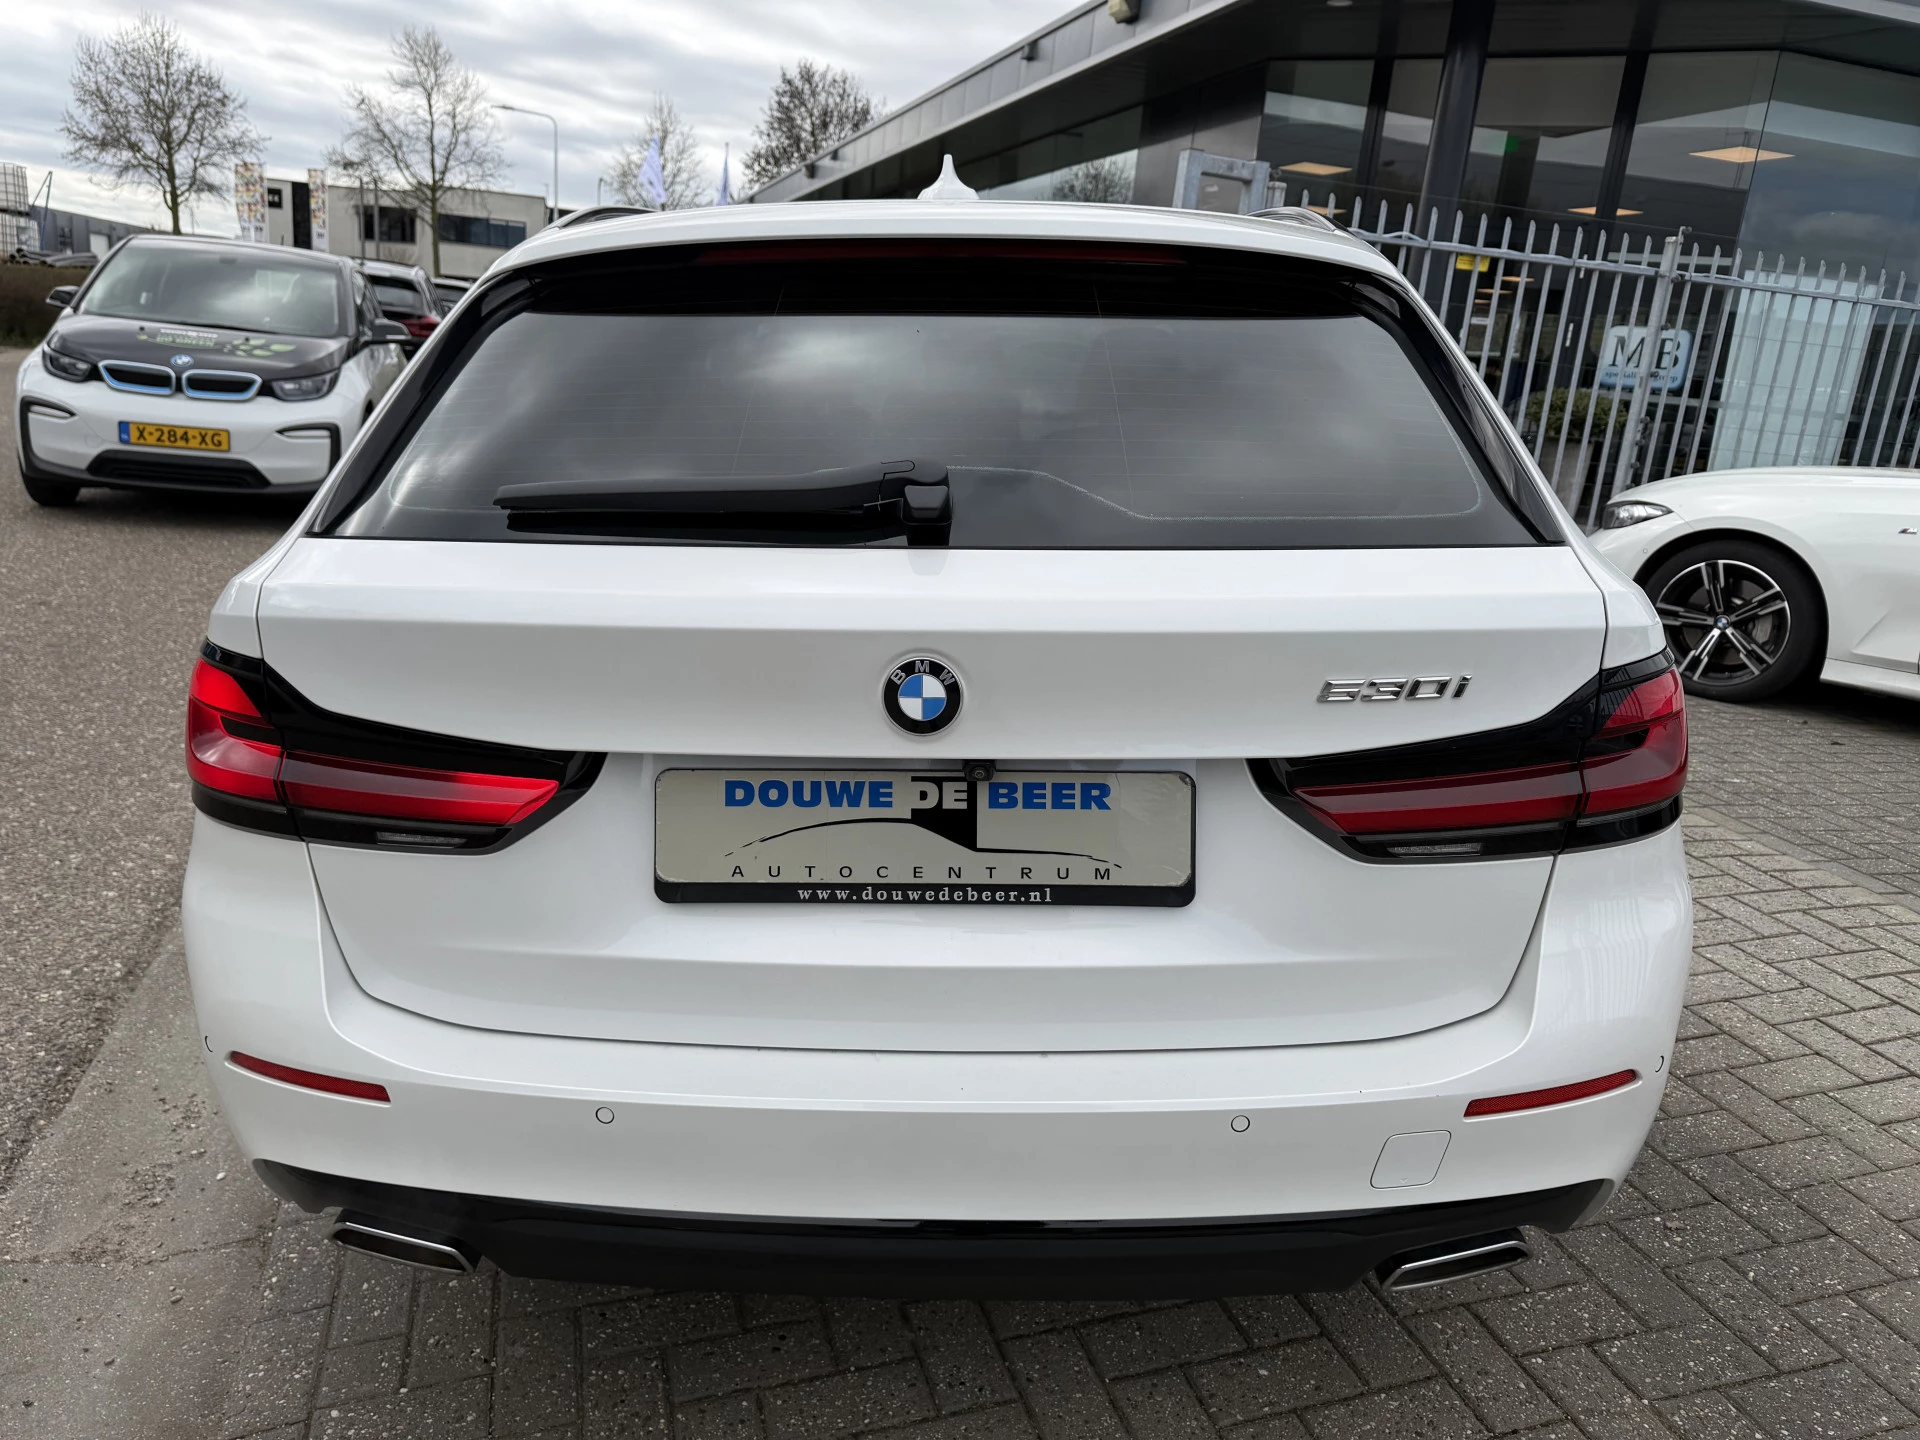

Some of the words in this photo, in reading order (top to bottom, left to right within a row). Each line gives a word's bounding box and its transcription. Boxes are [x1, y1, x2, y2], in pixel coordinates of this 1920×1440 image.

[136, 426, 222, 448] X-284-XG
[890, 660, 957, 686] BMW
[1317, 674, 1473, 703] 530i
[724, 780, 893, 808] DOUWE
[909, 781, 968, 809] DE
[988, 782, 1112, 811] BEER
[731, 865, 1111, 880] AUTOCENTRUM
[797, 887, 1052, 903] www.douwedebeer.nl
